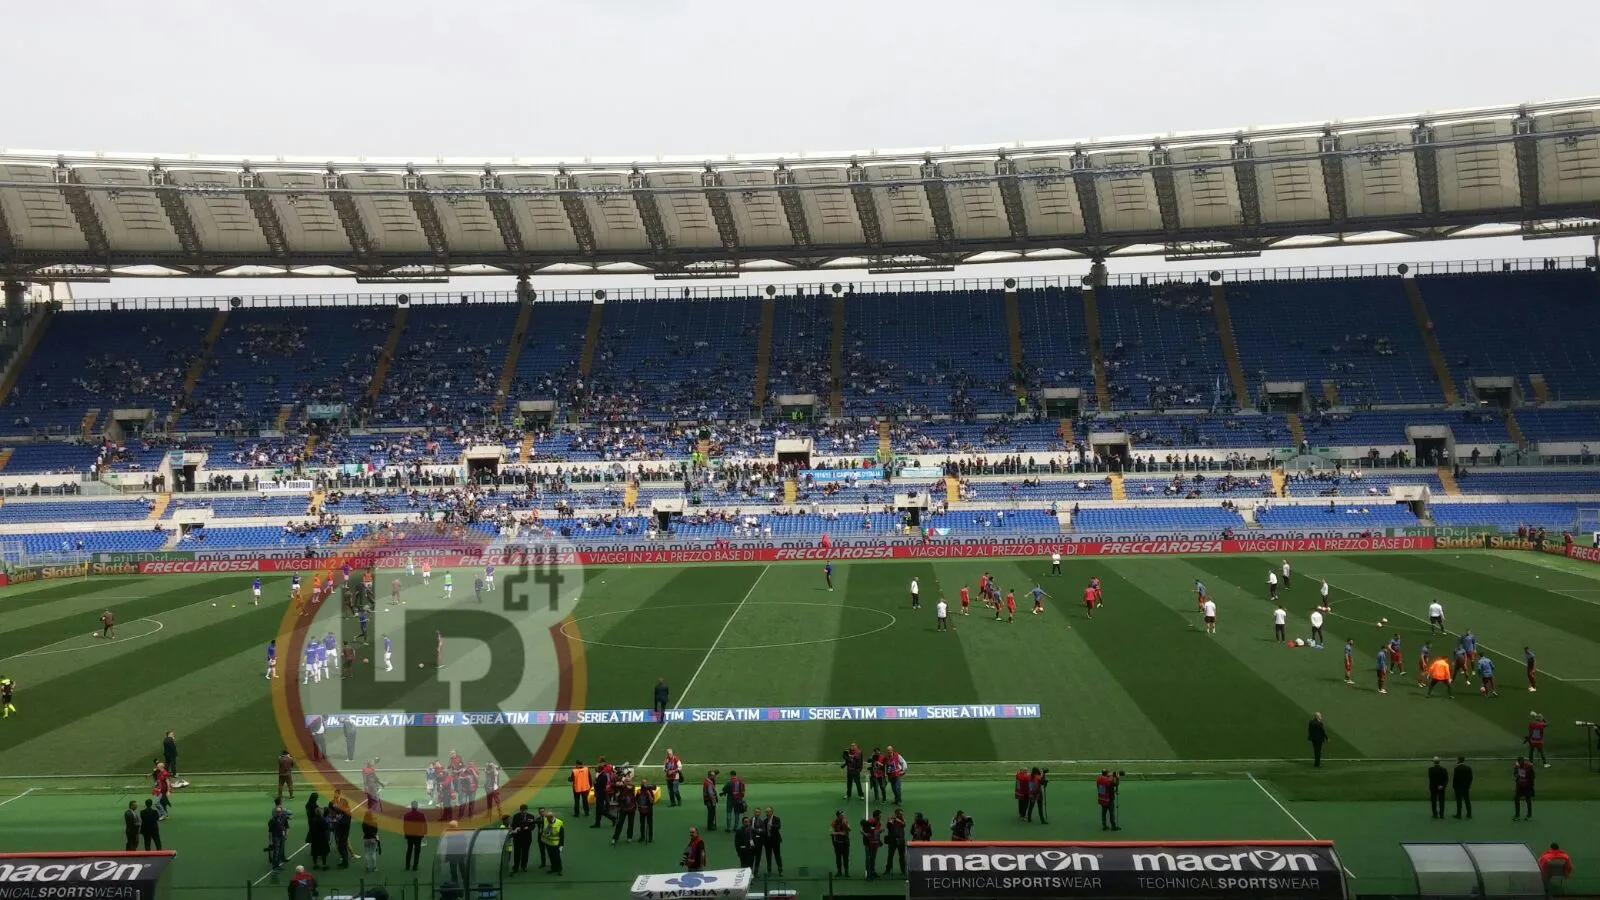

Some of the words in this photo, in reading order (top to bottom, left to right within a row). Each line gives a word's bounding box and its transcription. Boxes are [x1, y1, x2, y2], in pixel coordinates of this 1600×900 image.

[1100, 541, 1222, 554] FRECCIAROSSA
[1238, 540, 1278, 551] VIAGGI
[1282, 540, 1294, 551] IN
[1298, 540, 1304, 550] 2
[1308, 539, 1321, 550] AL
[1325, 539, 1369, 550] PREZZO
[1372, 539, 1399, 549] BASE
[1403, 538, 1415, 549] DI
[1436, 535, 1482, 548] Slotter
[1490, 536, 1536, 549] Slotter
[590, 552, 629, 563] VIAGGI
[631, 552, 642, 563] IN
[646, 552, 652, 562] 2
[655, 551, 668, 562] AL
[671, 551, 712, 561] PREZZO
[715, 550, 739, 561] BASE
[743, 550, 755, 560] DI
[776, 547, 894, 560] FRECCIAROSSA
[909, 546, 947, 557] VIAGGI
[951, 546, 962, 556] IN
[966, 546, 973, 556] 2
[976, 545, 988, 556] AL
[993, 544, 1034, 555] PREZZO
[1037, 544, 1063, 554] BASE
[1067, 543, 1078, 554] DI
[274, 559, 311, 570] VIAGGI
[315, 559, 327, 570] IN
[330, 559, 337, 570] 2
[428, 556, 438, 566] DI
[459, 553, 575, 567] FRECCIAROSSA
[42, 565, 87, 579] Slotter
[93, 562, 138, 575] Slotter
[143, 560, 260, 574] FRECCIAROSSA
[577, 711, 606, 723] SERIE
[606, 711, 617, 723] A
[618, 711, 644, 722] TIM
[665, 710, 684, 721] TIM
[693, 710, 724, 721] SERIE
[724, 709, 736, 721] A
[737, 709, 760, 720] TIM
[780, 708, 800, 719] TIM
[809, 708, 840, 719] SERIE
[841, 708, 852, 719] A
[853, 707, 877, 719] TIM
[898, 707, 918, 718] TIM
[927, 707, 958, 718] SERIE
[959, 706, 970, 718] A
[970, 706, 996, 717] TIM
[1016, 705, 1037, 716] TIM
[350, 715, 379, 726] SERIE
[380, 715, 391, 726] A
[391, 714, 415, 726] TIM
[435, 714, 454, 725] TIM
[462, 714, 493, 725] SERIE
[494, 713, 504, 725] A
[505, 712, 529, 724] TIM
[549, 712, 569, 723] TIM
[922, 850, 1100, 872] macron
[1132, 850, 1318, 872] macron
[0, 860, 143, 882] acron
[660, 889, 718, 899] PAIDEIA
